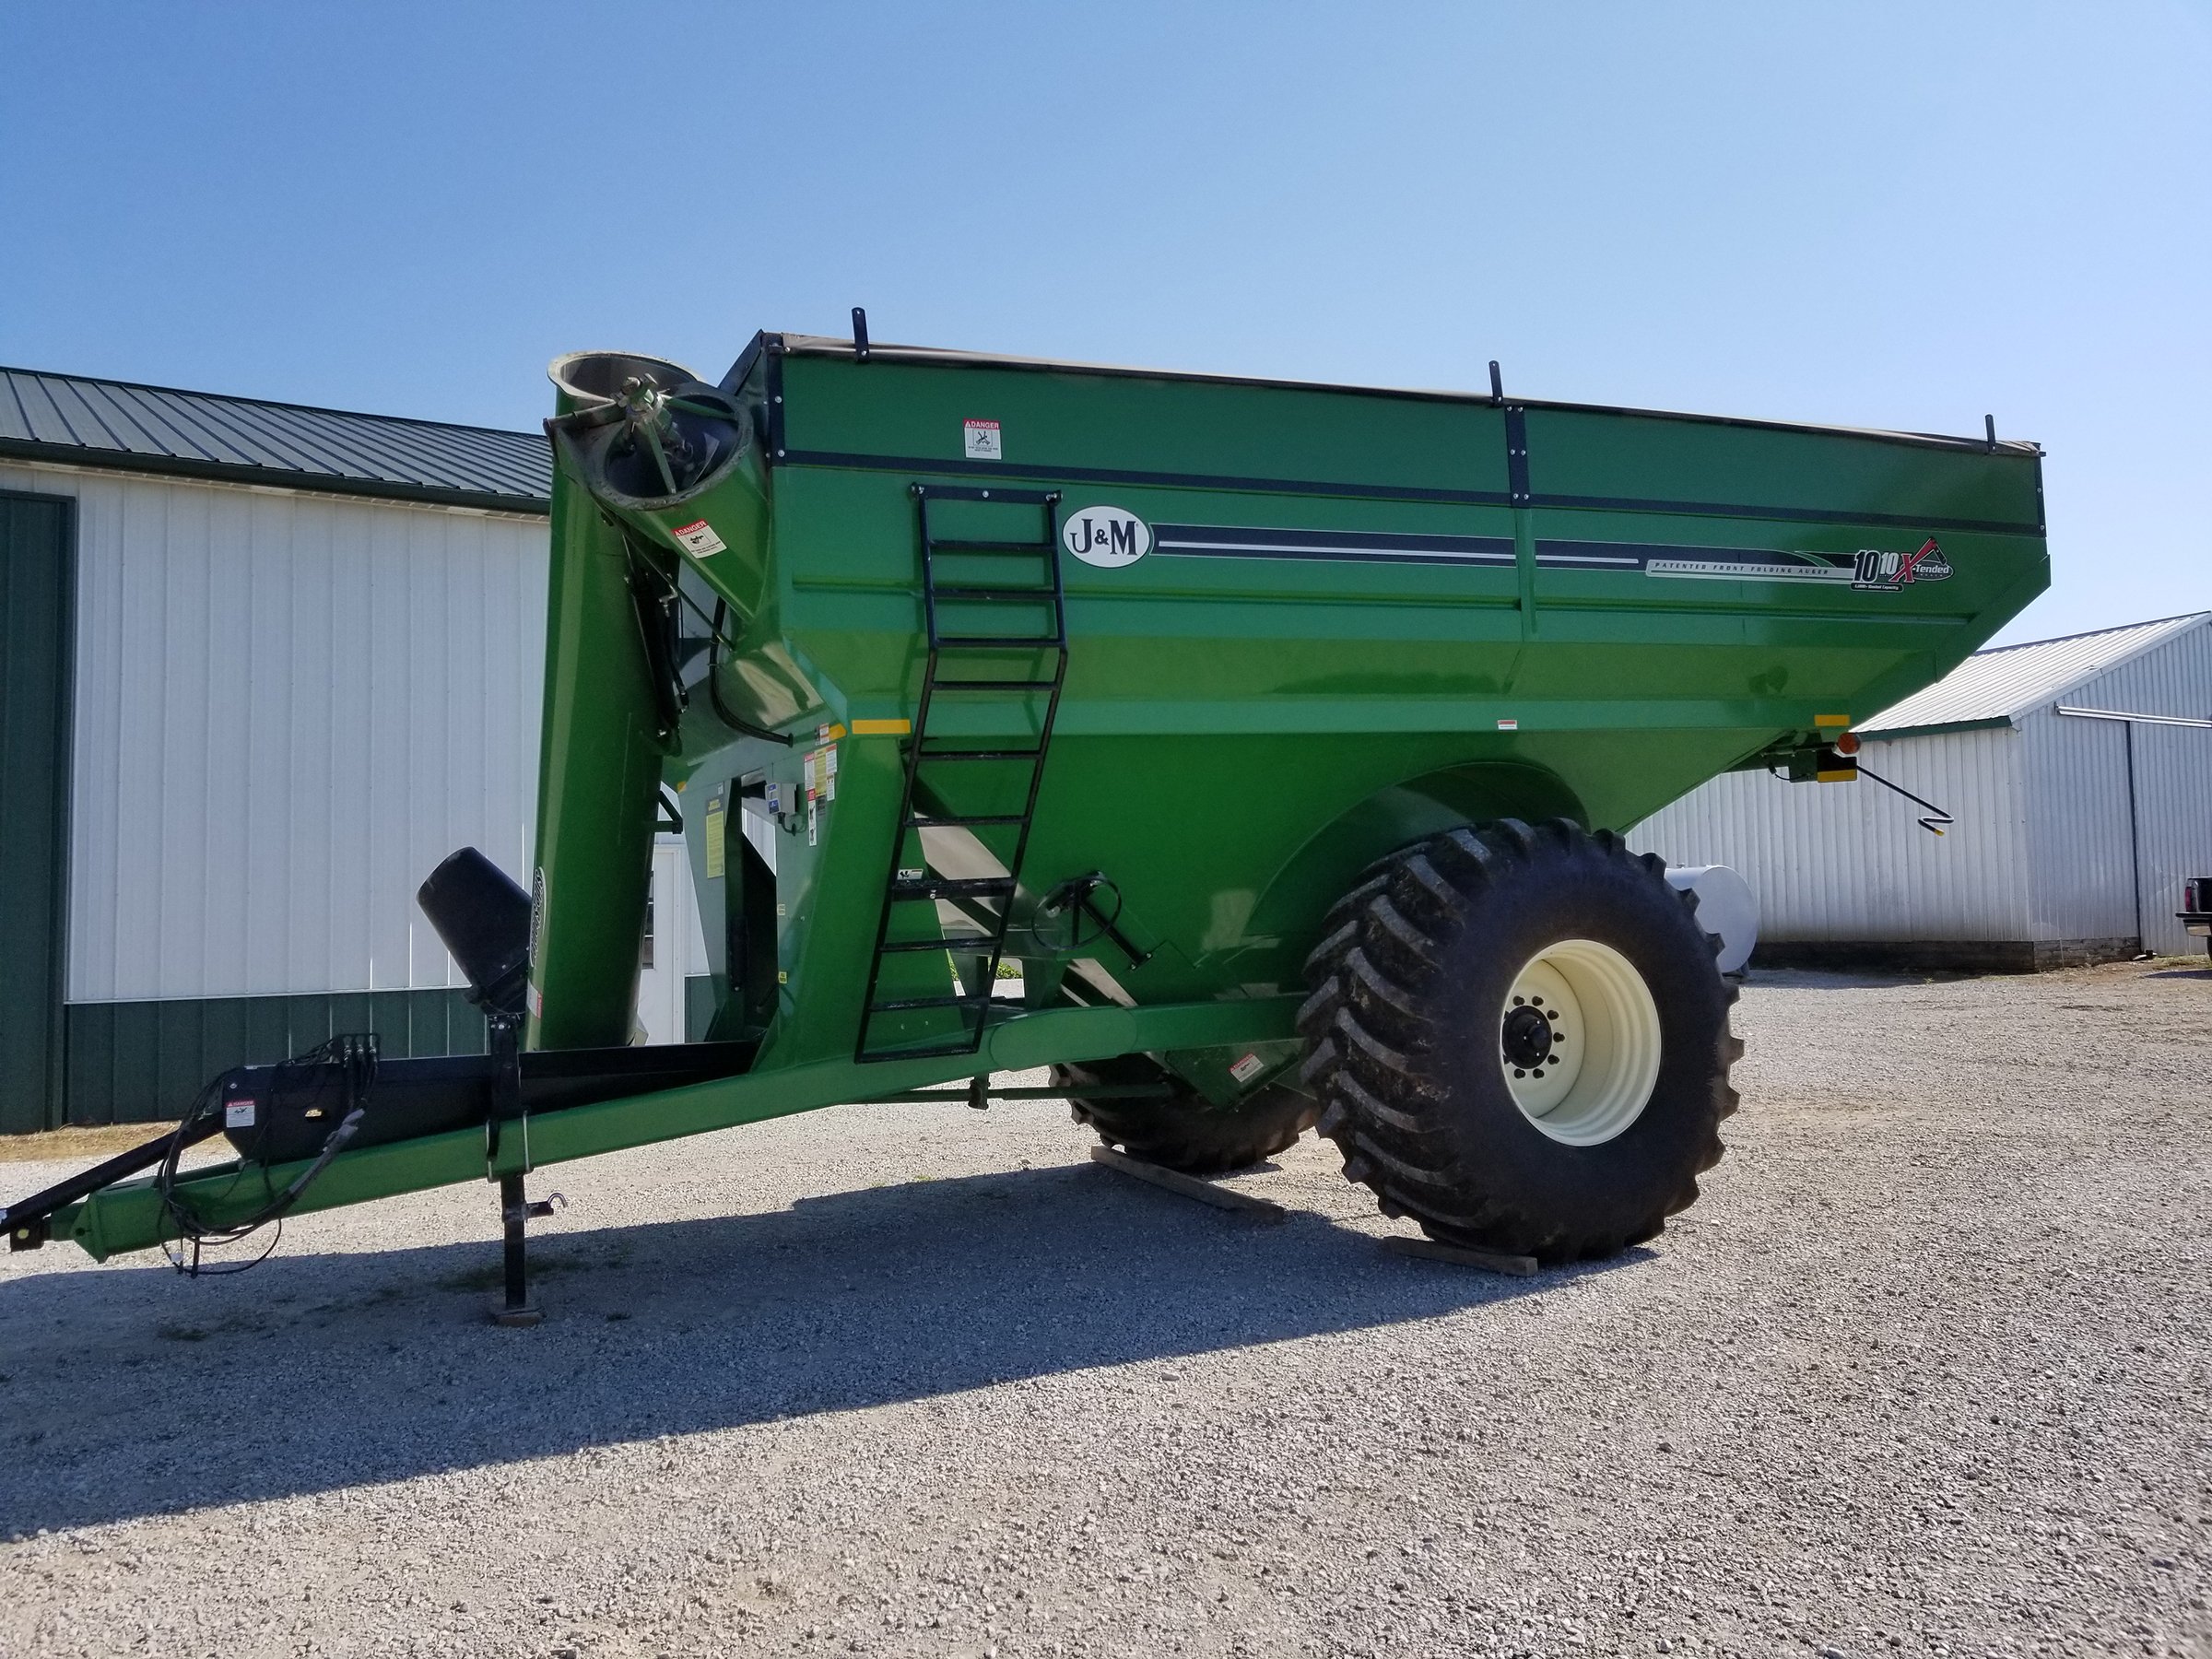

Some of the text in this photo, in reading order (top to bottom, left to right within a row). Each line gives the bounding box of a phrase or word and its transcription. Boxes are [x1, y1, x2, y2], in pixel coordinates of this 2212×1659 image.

[971, 420, 999, 429] DANGER
[680, 520, 707, 535] DANGER
[1069, 518, 1137, 556] J&M
